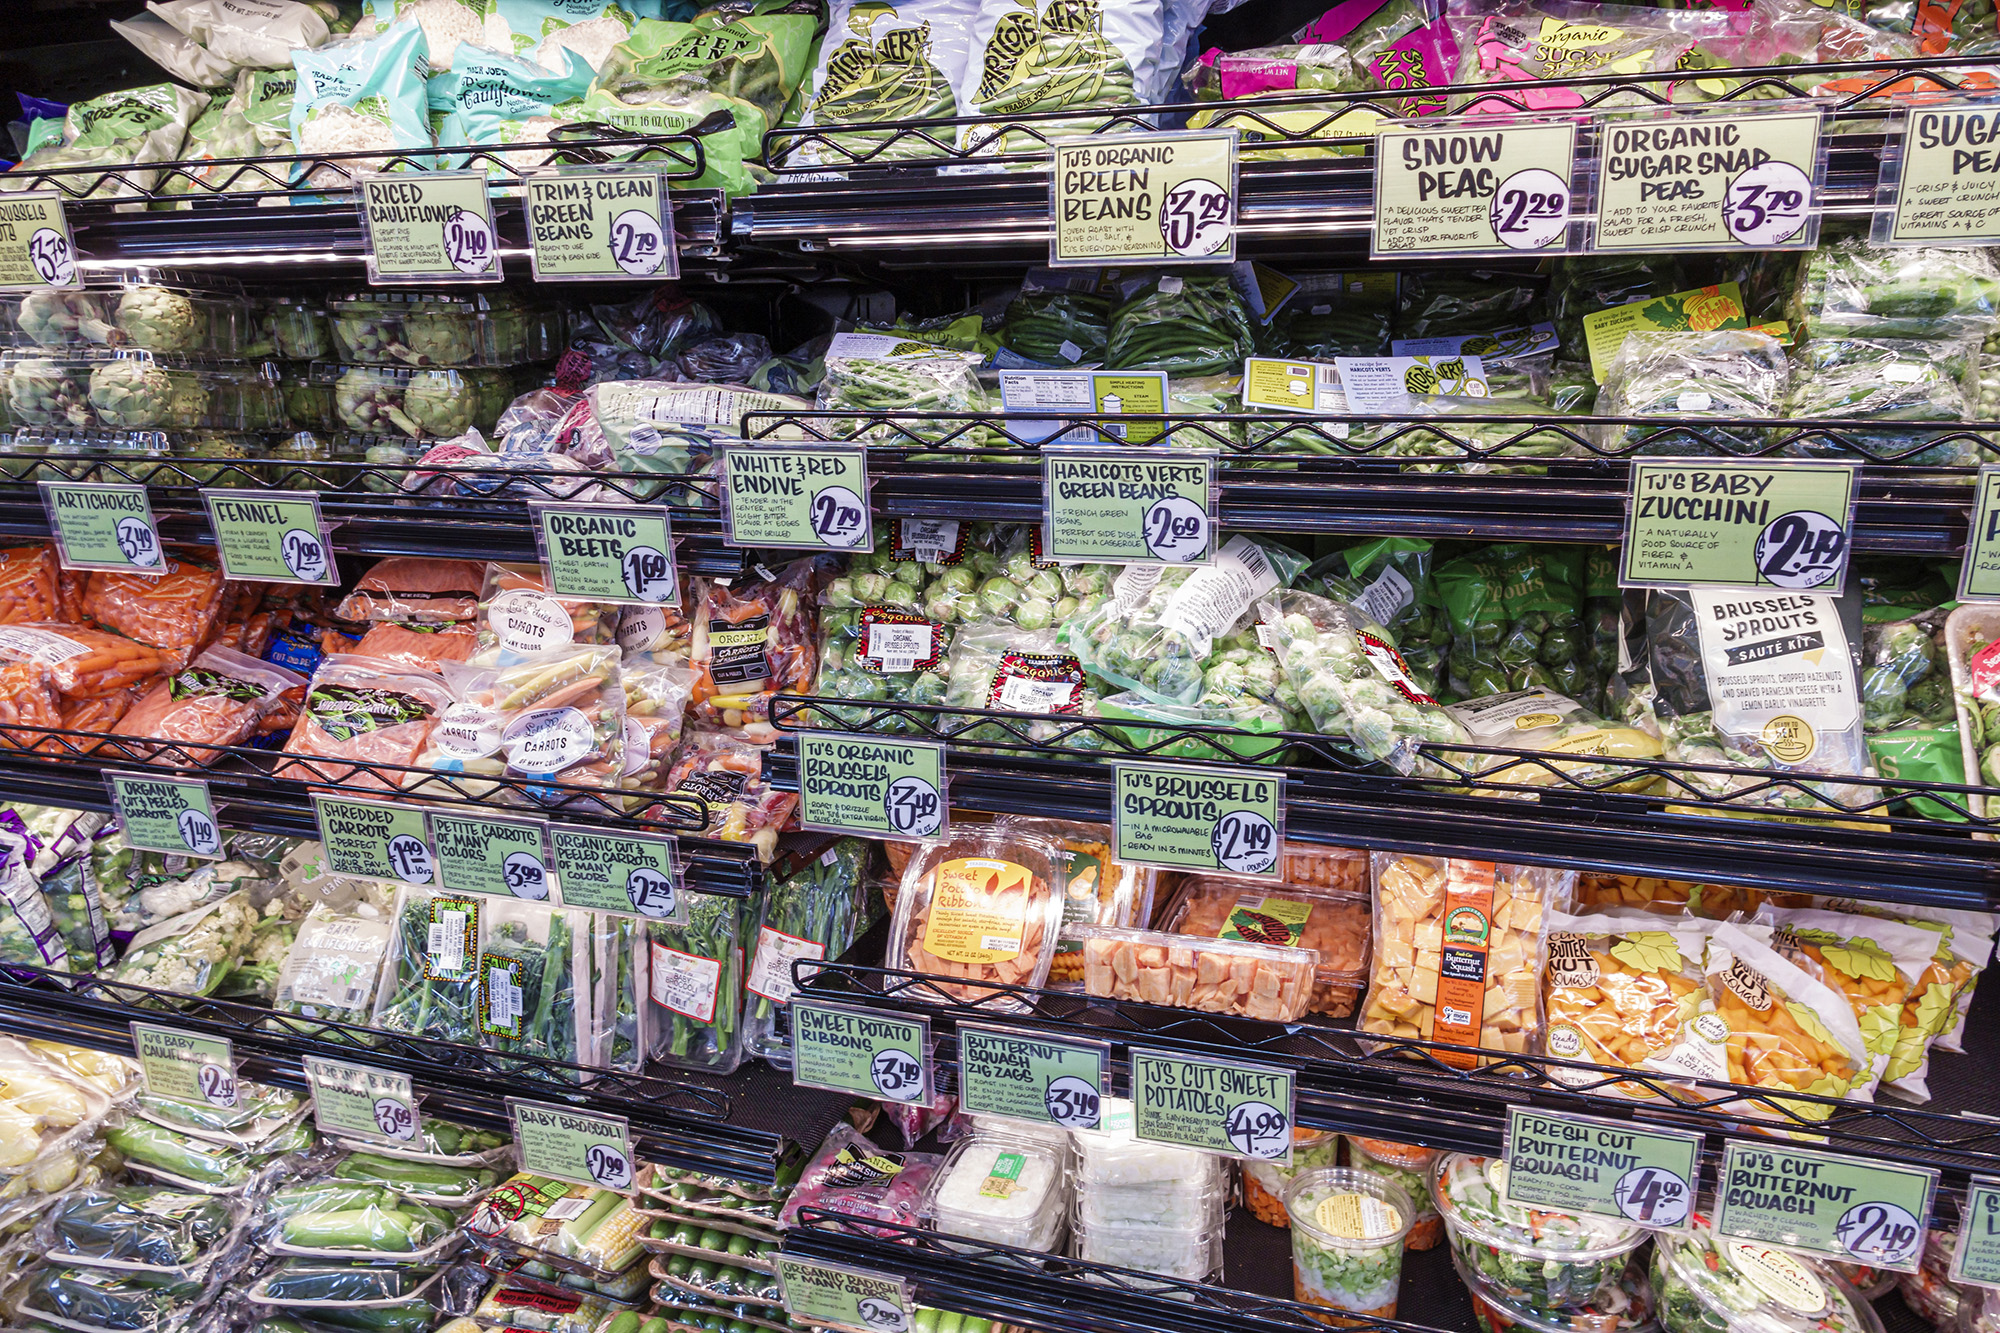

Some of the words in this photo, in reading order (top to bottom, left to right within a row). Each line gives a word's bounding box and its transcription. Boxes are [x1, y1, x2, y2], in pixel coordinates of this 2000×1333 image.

[1542, 29, 1608, 43] organic
[1614, 124, 1740, 153] ORGANIC
[1063, 150, 1090, 168] TJ'S
[1096, 147, 1174, 165] ORGANIC
[1403, 134, 1503, 170] SNOW
[1609, 155, 1692, 181] SUGAR
[1698, 148, 1770, 174] SNAP
[533, 184, 579, 201] TRIM
[599, 180, 652, 200] CLEAN
[1065, 168, 1149, 194] GREEN
[1419, 169, 1495, 201] PEAS
[1641, 180, 1704, 201] PEAS
[370, 183, 423, 204] RICED
[372, 205, 464, 223] CAULIFLOWER
[533, 204, 593, 224] GREEN
[1064, 193, 1151, 222] BEANS
[1384, 217, 1414, 225] FLAVOR
[1603, 218, 1631, 227] SALAD
[1638, 217, 1654, 225] FOR
[1670, 214, 1707, 223] FRESH,
[1603, 228, 1636, 236] SWEET
[1641, 226, 1671, 234] CRISP
[1674, 223, 1716, 232] CRUNCH
[1901, 220, 1948, 230] VITAMINS
[1965, 220, 1971, 231] &
[1976, 220, 1986, 228] C
[538, 224, 592, 240] BEANS
[1594, 322, 1609, 330] BABY
[1610, 315, 1635, 326] ZUCCHINI
[731, 455, 792, 473] WHITE
[796, 457, 806, 480] &
[808, 457, 846, 475] RED
[1055, 463, 1143, 482] HARICOTS
[1147, 466, 1203, 485] VERTS
[733, 475, 804, 495] ENDIVE
[1059, 482, 1115, 499] GREEN
[1118, 483, 1178, 499] BEANS
[1644, 473, 1686, 491] TJ'S
[1692, 473, 1774, 496] BABY
[58, 492, 144, 513] ARTICHOKES
[216, 502, 287, 524] FENNEL
[1639, 496, 1769, 525] ZUCCHINI
[551, 516, 636, 537] ORGANIC
[559, 537, 624, 559] BEETS
[1641, 541, 1666, 549] GOOD
[1670, 541, 1705, 550] SOURCE
[1708, 541, 1719, 550] OF
[1713, 596, 1815, 621] BRUSSELS
[509, 618, 545, 637] CARROTS
[1724, 611, 1817, 641] SPROUTS
[1739, 641, 1783, 661] SAUTÉ
[1788, 633, 1813, 650] KIT
[1741, 699, 1763, 710] LEMON
[1765, 698, 1786, 709] GARLIC
[1788, 697, 1826, 708] VINAIGRETTE
[525, 738, 567, 752] CARROTS
[807, 743, 834, 756] TJ'S
[838, 745, 914, 765] ORGANIC
[807, 758, 888, 781] BRUSSELS
[124, 783, 180, 798] ORGANIC
[806, 778, 881, 801] SPROUTS
[1123, 773, 1152, 788] TJ'S
[1156, 776, 1268, 802] BRUSSELS
[122, 795, 139, 807] CUT
[150, 798, 188, 809] PEELED
[1125, 793, 1218, 821] SPROUTS
[125, 809, 173, 819] CARROTS
[324, 803, 394, 824] SHREDDED
[330, 819, 390, 839] CARROTS
[437, 819, 478, 835] PETITE
[482, 825, 537, 845] CARROTS
[438, 833, 450, 844] OF
[455, 834, 489, 851] MANY
[556, 835, 612, 852] ORGANIC
[615, 842, 634, 853] CUT
[442, 846, 486, 861] COLORS
[557, 848, 599, 860] PEELED
[602, 852, 659, 867] CARROTS
[560, 861, 571, 869] OF
[575, 862, 612, 874] MANY
[568, 871, 609, 882] COLORS
[1445, 953, 1480, 967] Butternut
[1450, 961, 1476, 973] Squash
[801, 1010, 855, 1034] SWEET
[858, 1019, 911, 1042] POTATO
[142, 1033, 162, 1045] TJ'S
[164, 1036, 194, 1050] BABY
[802, 1029, 873, 1052] RIBBONS
[968, 1036, 1066, 1063] BUTTERNUT
[969, 1049, 1030, 1069] SQUASH
[968, 1063, 991, 1078] ZIG
[995, 1066, 1033, 1083] ZAGS
[1140, 1060, 1175, 1085] TJ'S
[1182, 1064, 1215, 1090] CUT
[1220, 1070, 1279, 1099] SWEET
[1145, 1084, 1225, 1116] POTATOES
[520, 1109, 557, 1129] BABY
[560, 1118, 621, 1139] BROCCOLI
[1522, 1118, 1588, 1142] FRESH
[1597, 1132, 1636, 1150] CUT
[1519, 1136, 1641, 1170] BUTTERNUT
[1512, 1156, 1599, 1183] SQUASH
[1737, 1152, 1773, 1171] TJ'S
[1781, 1158, 1824, 1179] CUT
[1732, 1170, 1856, 1203] BUTTERNUT
[1728, 1188, 1815, 1215] SQUASH
[784, 1263, 843, 1285] ORGANIC
[847, 1275, 898, 1295] RADISH
[784, 1272, 798, 1281] OF
[802, 1276, 842, 1290] MANY
[845, 1285, 891, 1301] COLORS
